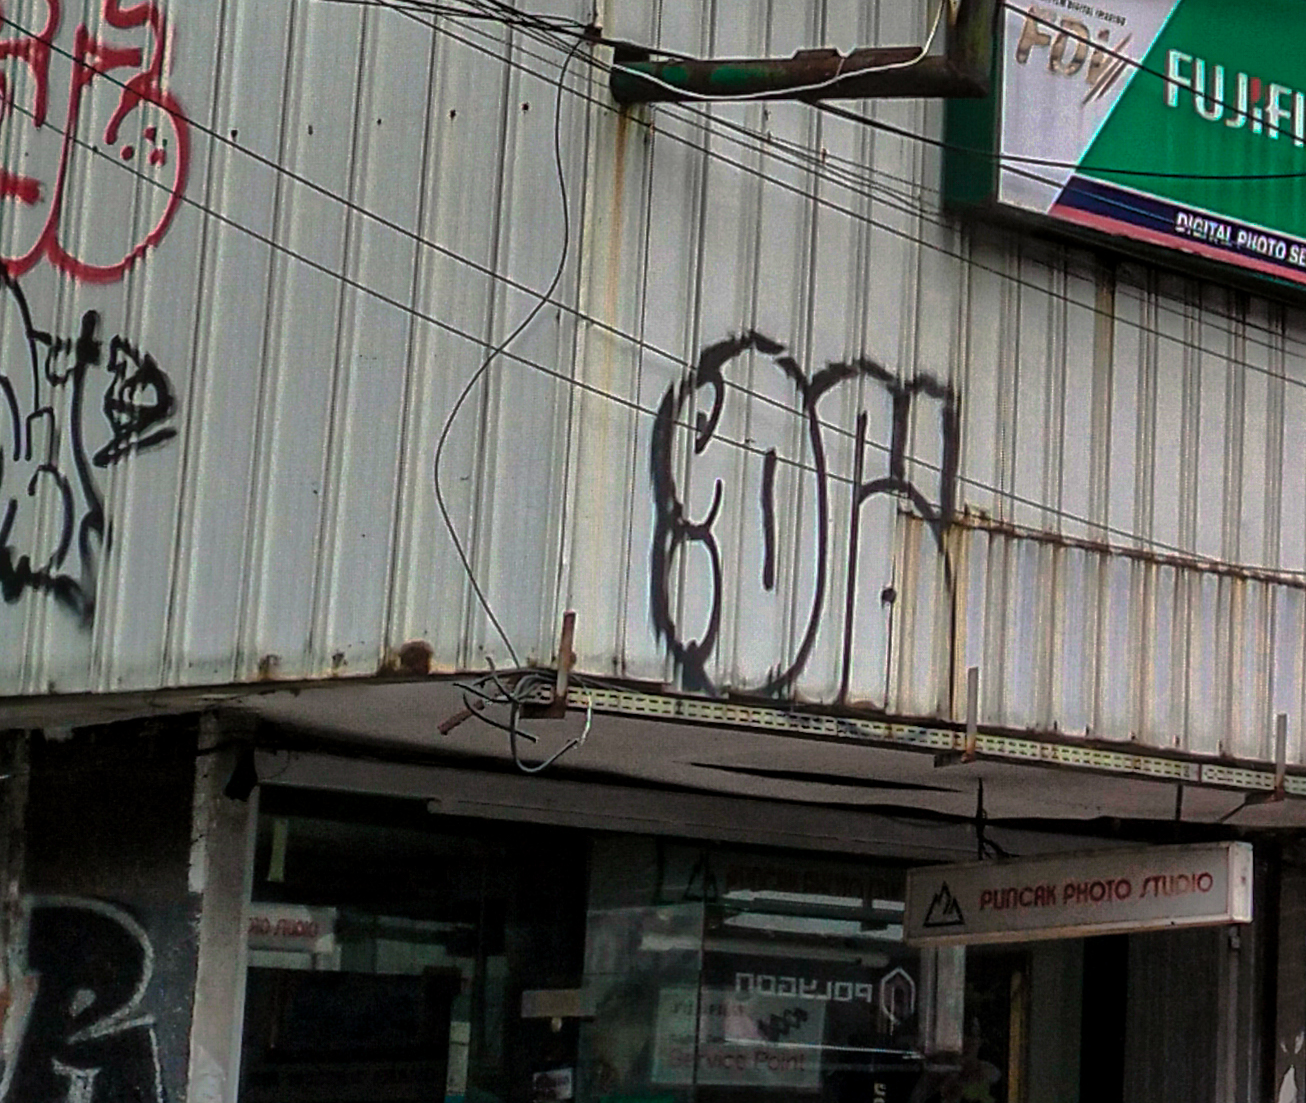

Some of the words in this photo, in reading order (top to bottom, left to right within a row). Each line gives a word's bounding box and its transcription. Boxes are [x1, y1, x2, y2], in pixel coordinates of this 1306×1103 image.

[1175, 211, 1232, 245] DIGITAL
[1236, 230, 1287, 261] PHOTO
[979, 886, 1056, 910] PUNCAK
[1063, 879, 1132, 905] PHOTO
[1139, 872, 1214, 898] STUDIO
